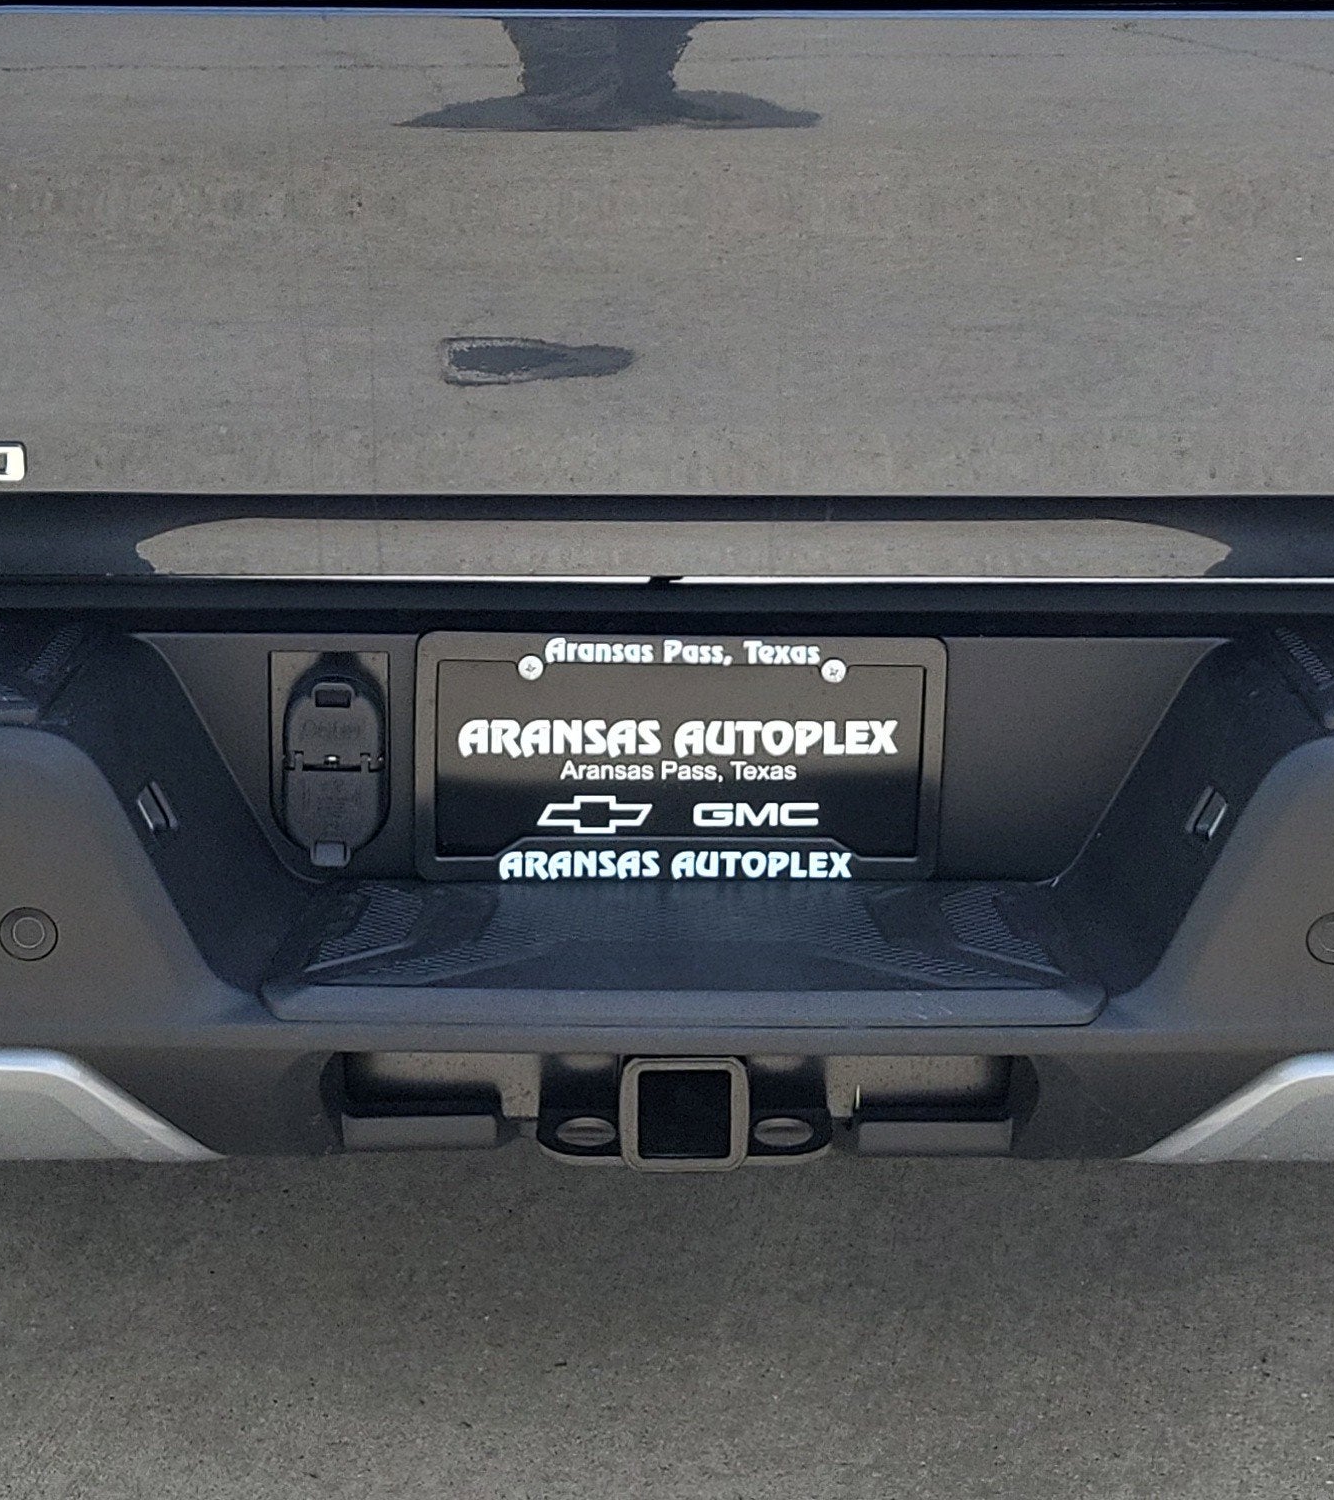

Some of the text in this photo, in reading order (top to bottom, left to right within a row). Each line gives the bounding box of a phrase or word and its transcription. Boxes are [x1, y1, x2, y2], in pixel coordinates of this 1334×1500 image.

[544, 636, 821, 667] Aransas Pass, Texas
[457, 718, 899, 759] ARANSAS AUTOPLEX
[559, 759, 798, 784] Aransas Pass, Texas
[692, 801, 820, 827] GMC
[497, 849, 853, 881] ARANSAS AUTOPLEX
